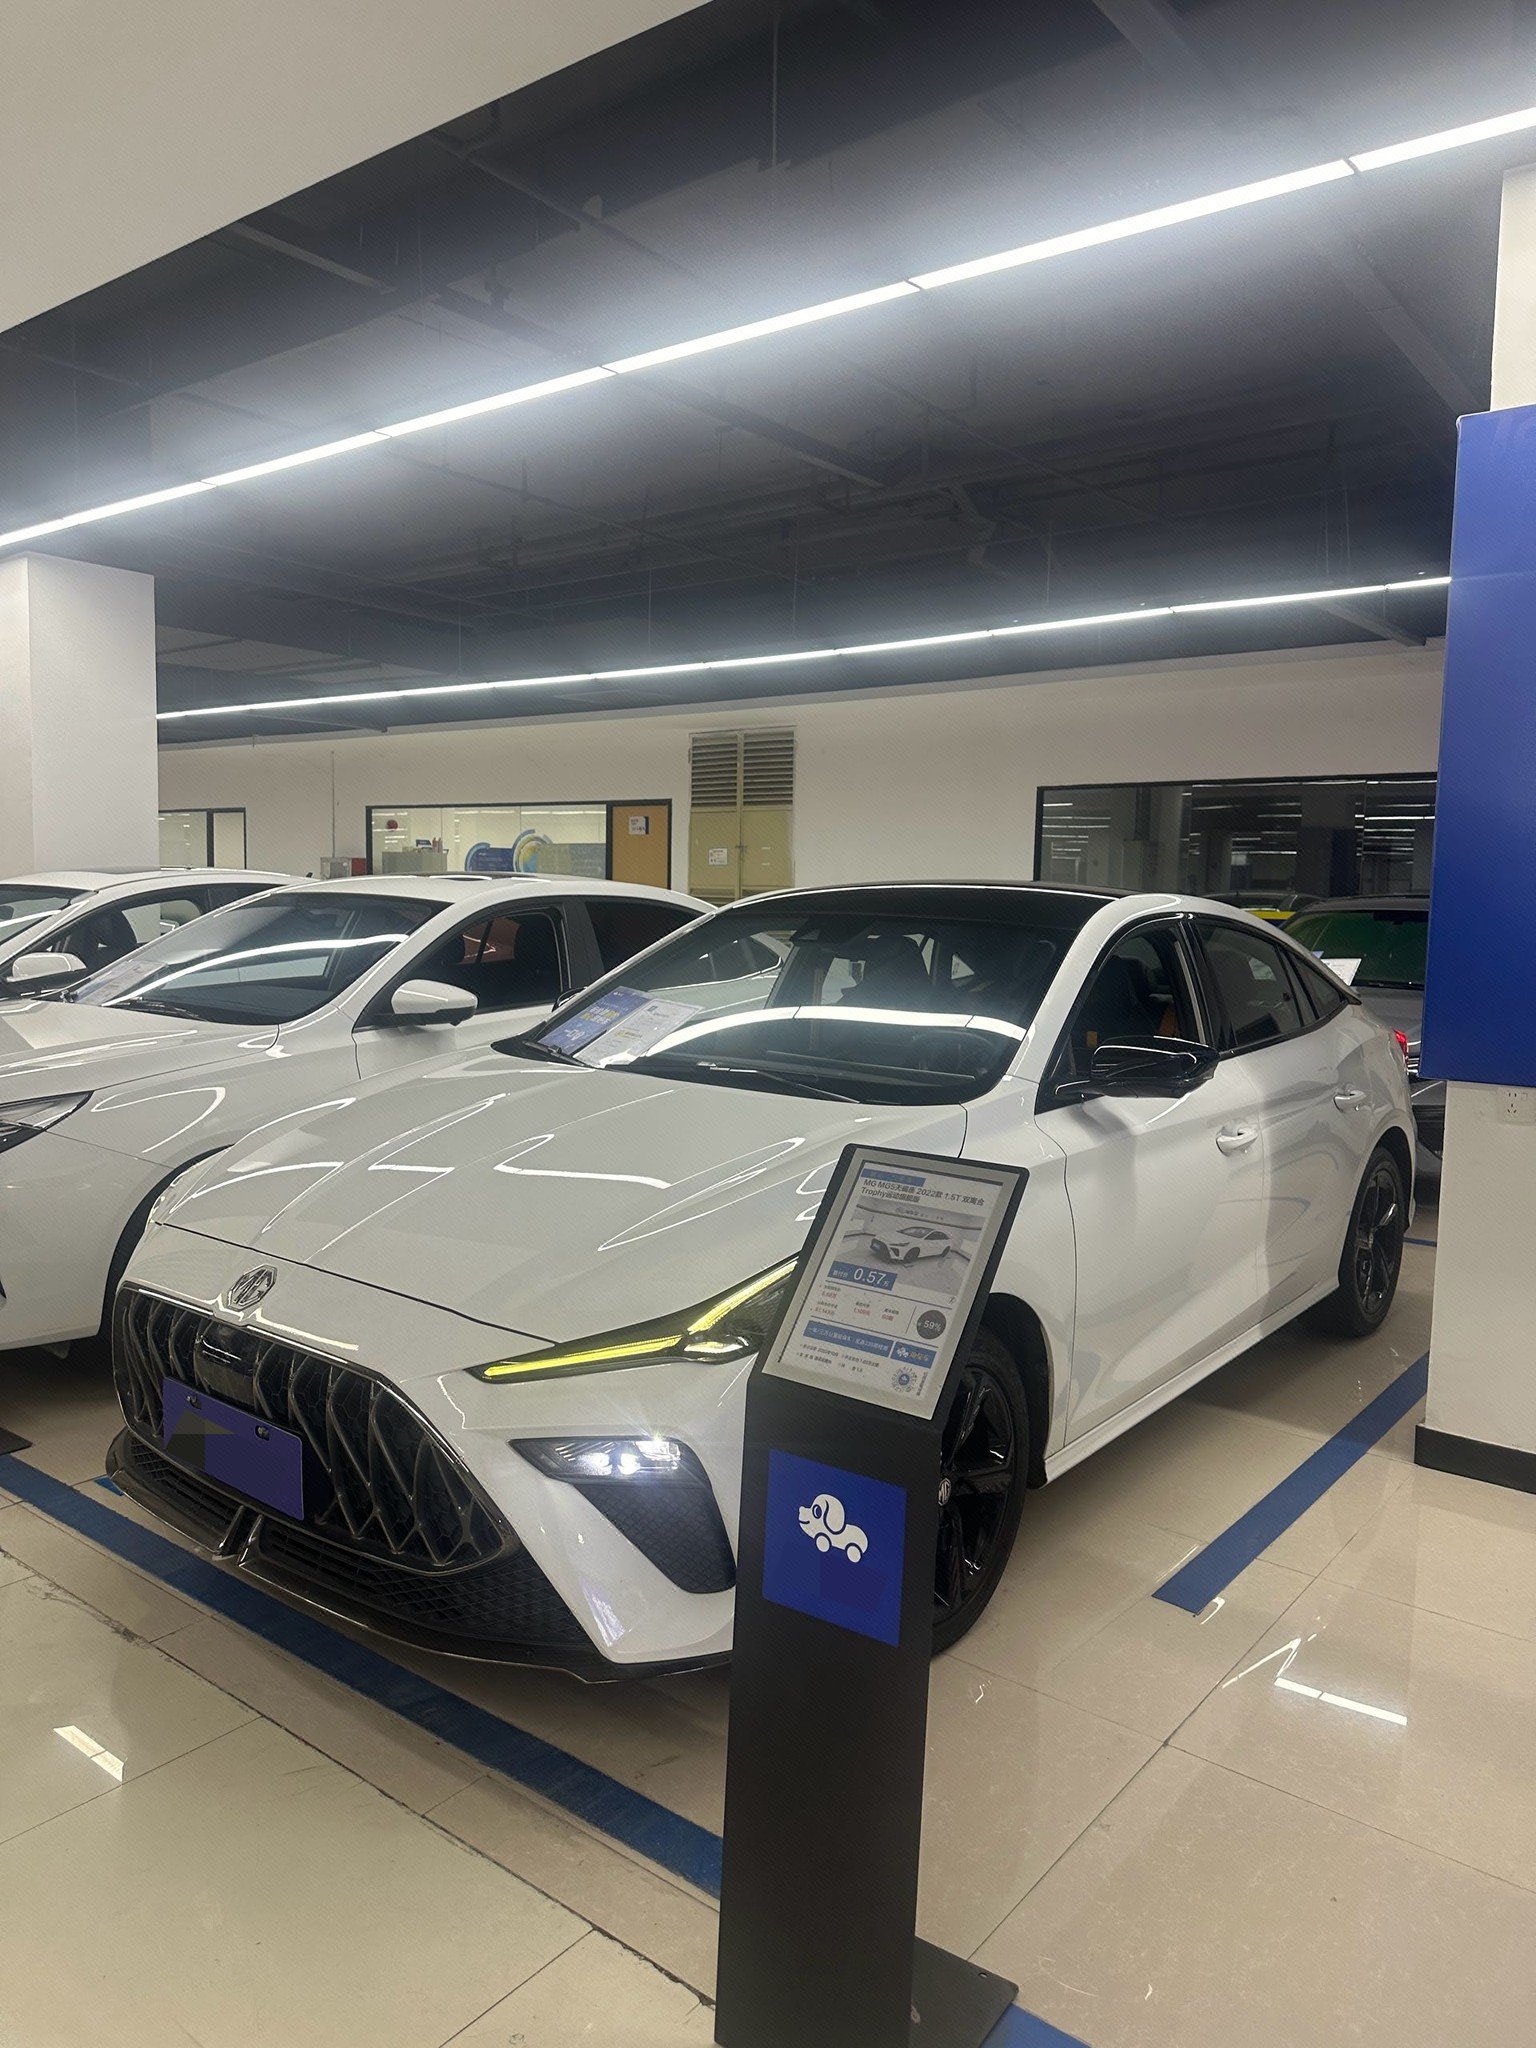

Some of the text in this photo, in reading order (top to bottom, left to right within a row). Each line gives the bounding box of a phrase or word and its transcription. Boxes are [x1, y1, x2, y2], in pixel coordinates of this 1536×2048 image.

[861, 1186, 921, 1203] Trophy运动
[863, 1179, 877, 1188] MG
[944, 1192, 961, 1202] 1.5T
[231, 1267, 275, 1307] MG
[923, 1319, 942, 1332] 59%
